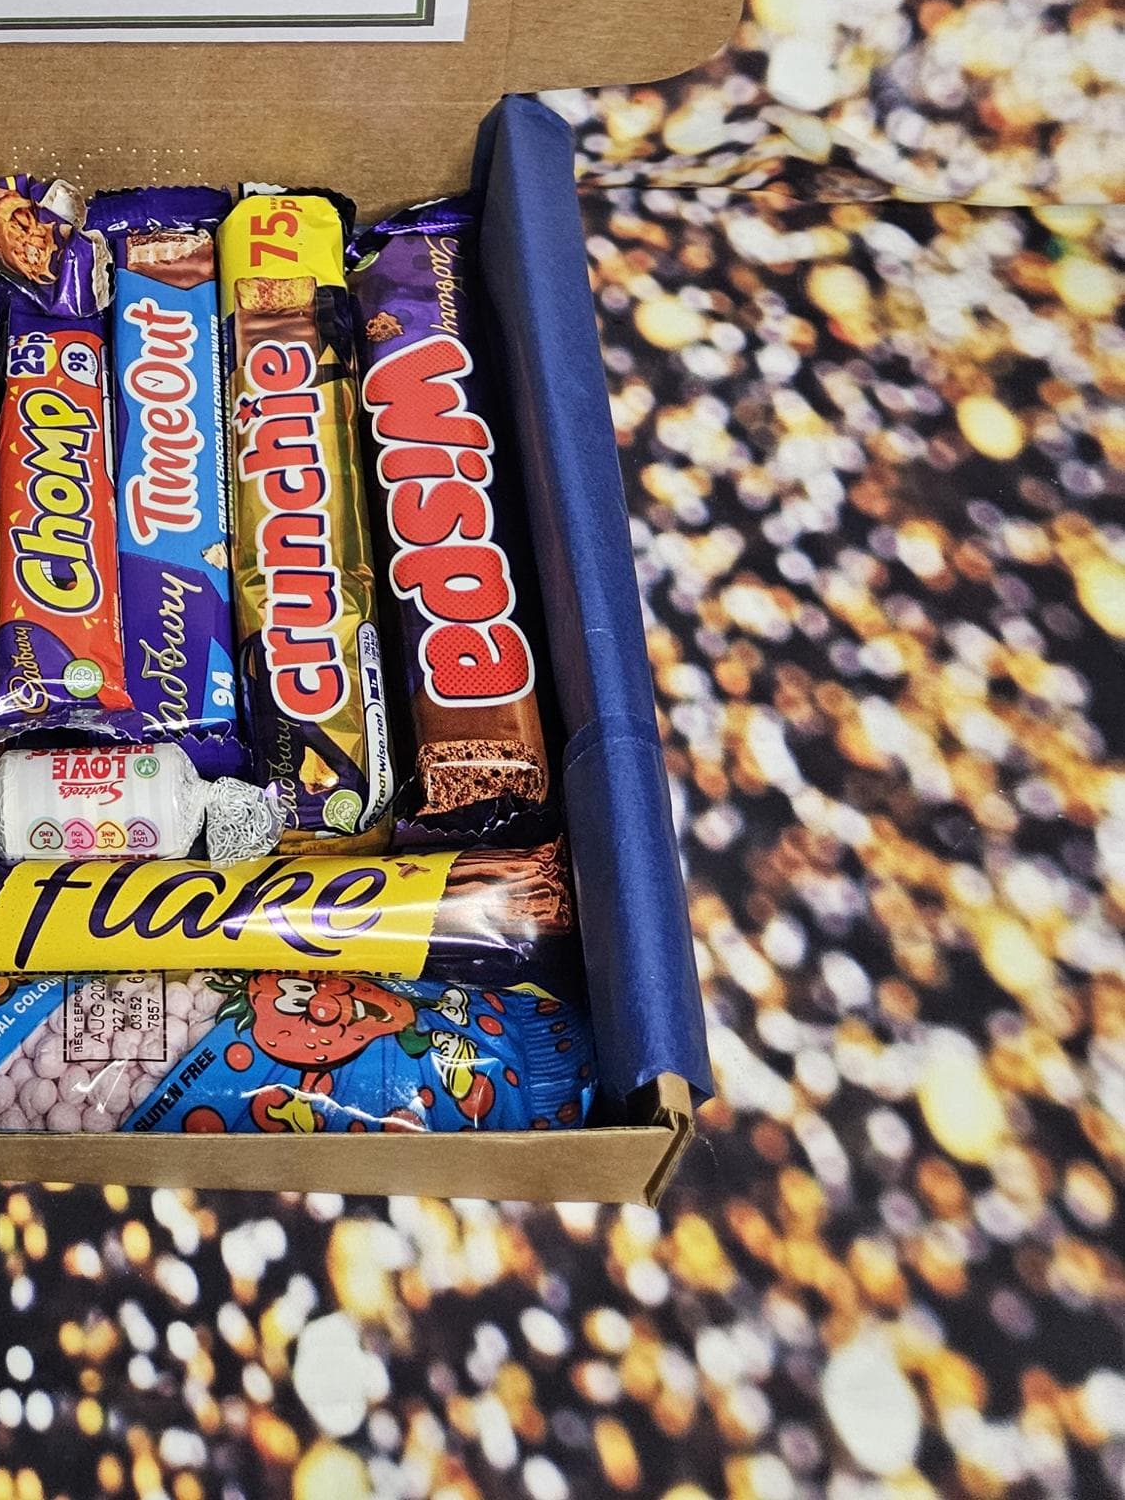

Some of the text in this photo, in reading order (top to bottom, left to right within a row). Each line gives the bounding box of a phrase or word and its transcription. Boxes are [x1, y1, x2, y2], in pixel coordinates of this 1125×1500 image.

[250, 199, 302, 267] 75p
[10, 332, 55, 377] 25p
[67, 352, 88, 371] 98
[127, 299, 203, 543] TimeOut
[209, 314, 228, 534] CREAMY CHOCOLATE COVERED WAFER
[365, 339, 531, 703] Wispa
[10, 626, 47, 714] Cadbury
[212, 671, 235, 707] 94
[52, 755, 126, 781] LOVE
[266, 717, 300, 822] adbury
[59, 781, 123, 805] Swizzels
[90, 976, 106, 1044] AUG 202
[113, 990, 126, 1032] 227 24
[130, 996, 143, 1031] 03:52
[147, 997, 160, 1029] 7857
[74, 1025, 83, 1053] BEST
[133, 1047, 217, 1133] GLUTEN FREE
